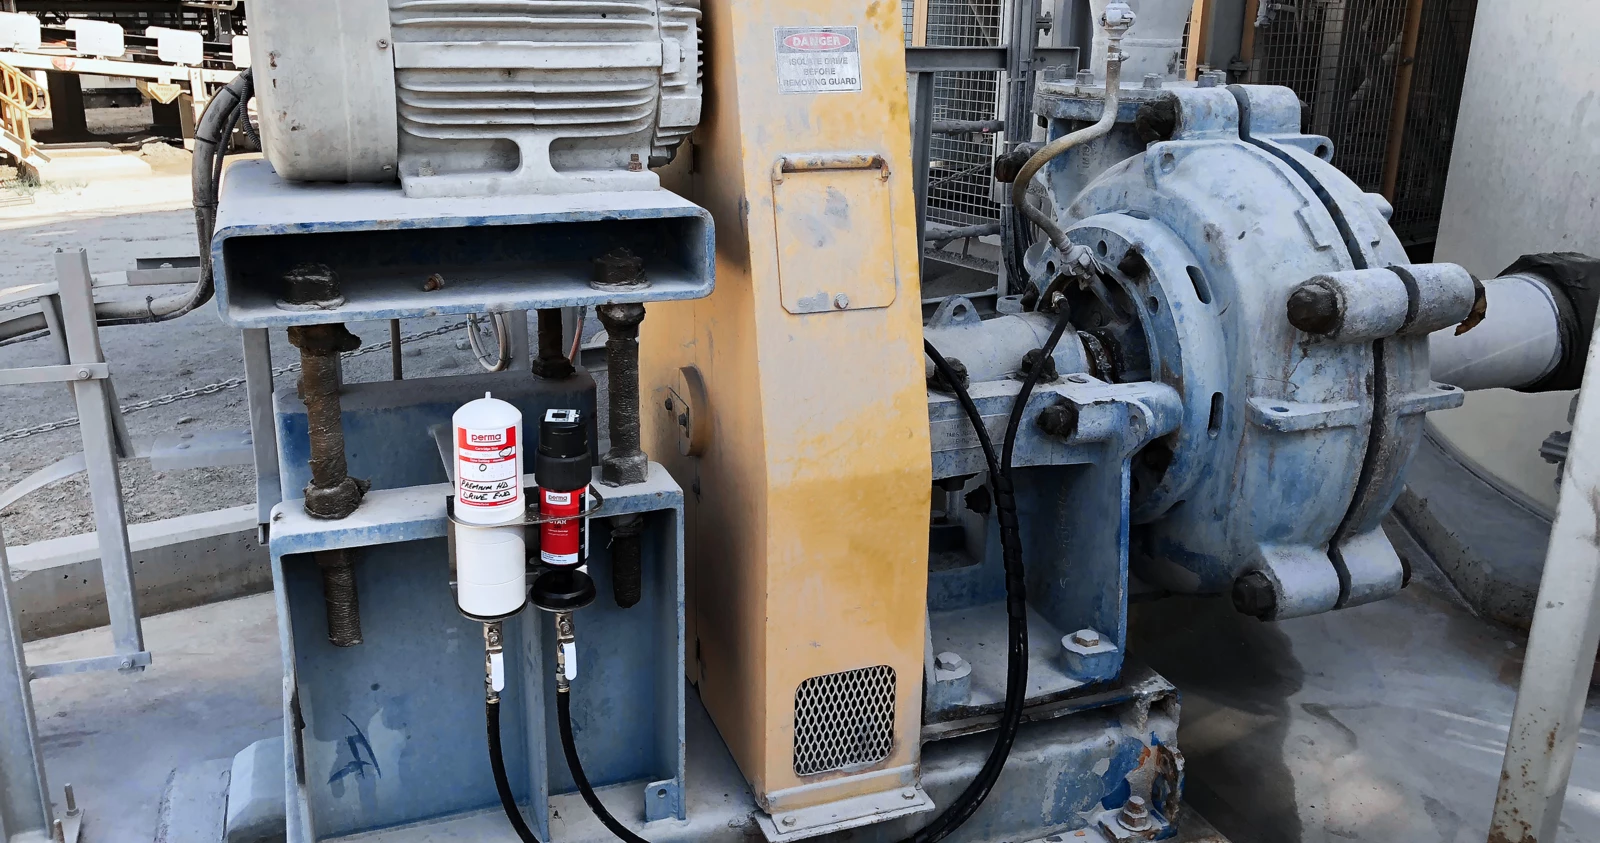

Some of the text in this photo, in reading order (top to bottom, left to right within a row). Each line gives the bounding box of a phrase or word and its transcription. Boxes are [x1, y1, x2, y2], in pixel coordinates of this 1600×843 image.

[792, 36, 841, 47] DANGER
[788, 57, 848, 66] ISOLATE DRIVE
[803, 67, 836, 76] BEFORE
[783, 77, 857, 87] REMOVING GUARD
[471, 433, 502, 443] perma
[548, 494, 568, 502] perma
